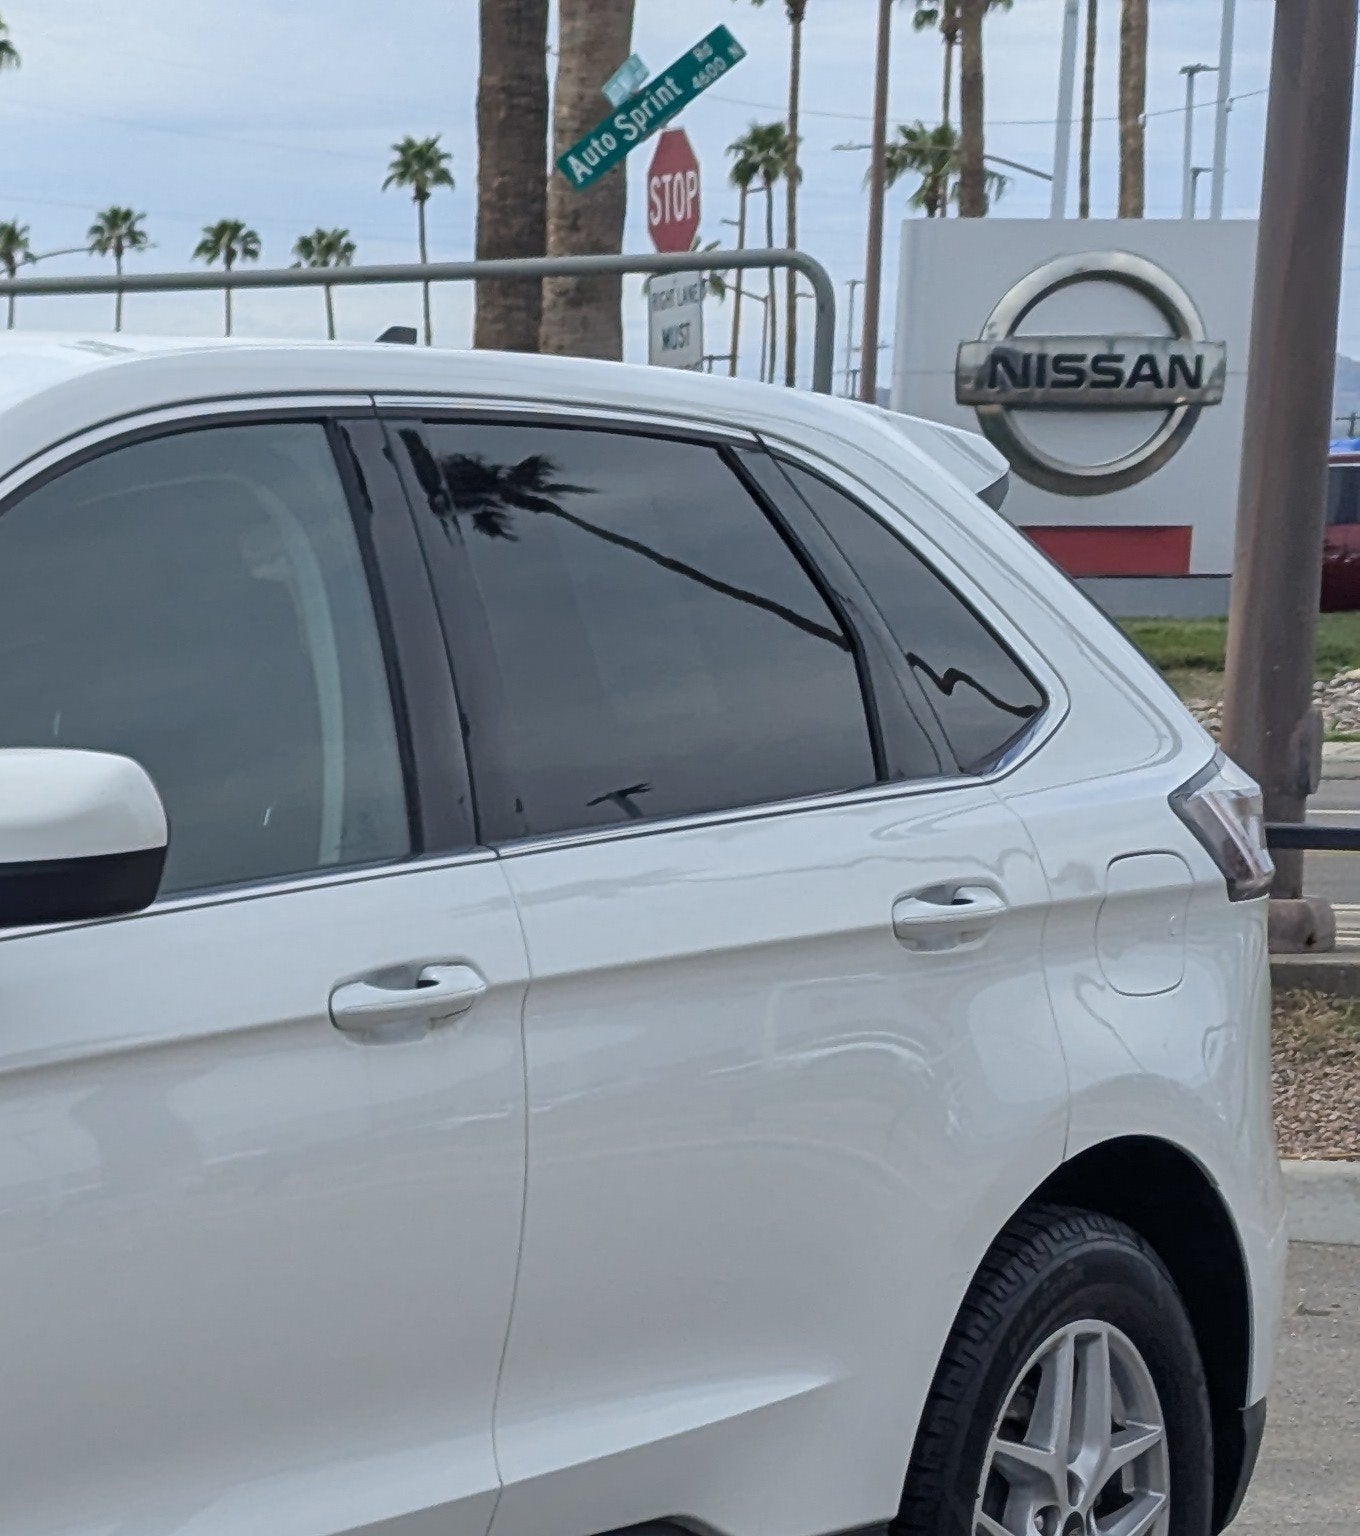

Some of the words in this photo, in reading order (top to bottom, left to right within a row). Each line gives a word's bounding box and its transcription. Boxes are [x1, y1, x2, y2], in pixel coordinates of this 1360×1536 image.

[567, 132, 617, 184] Auto
[614, 76, 684, 141] Sprint
[692, 42, 713, 62] Rd
[649, 170, 699, 227] STOP
[662, 321, 691, 352] MUST
[987, 353, 1204, 390] NISSAN
